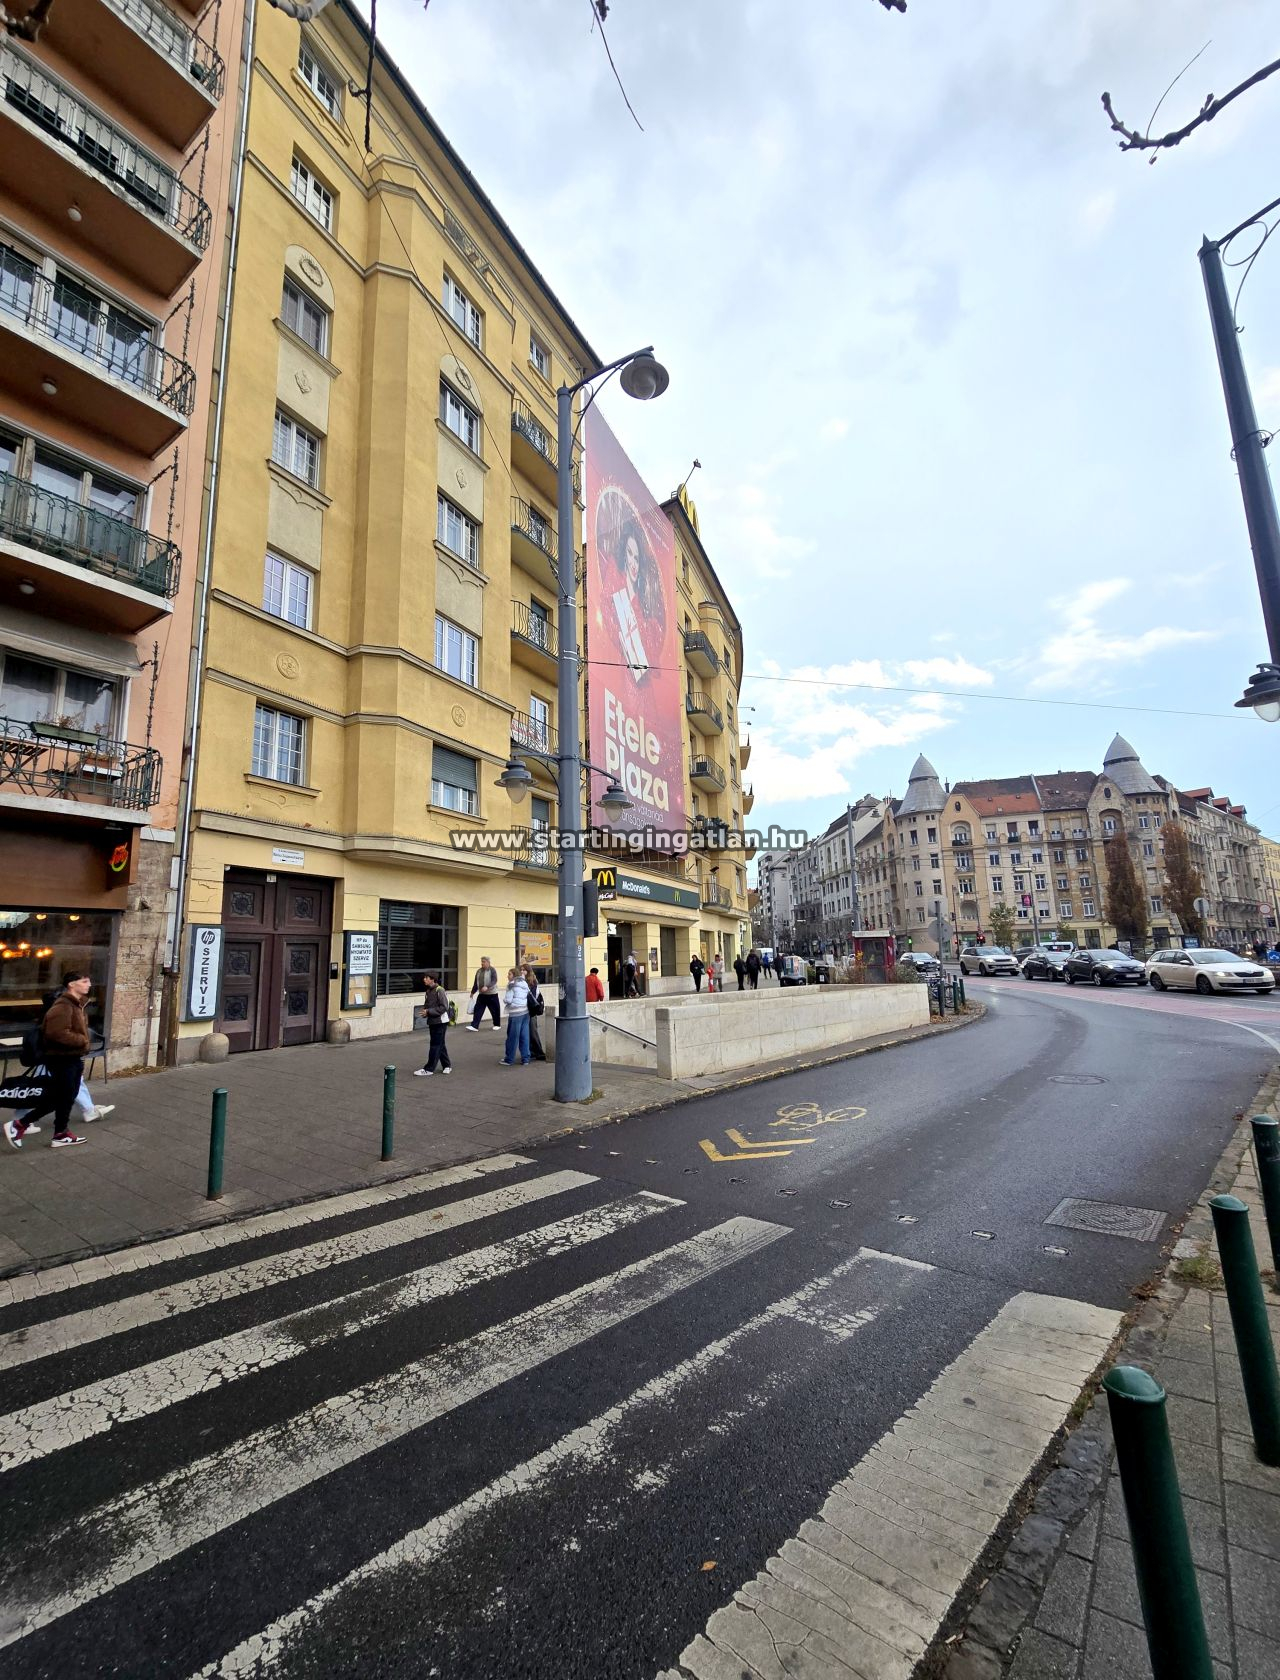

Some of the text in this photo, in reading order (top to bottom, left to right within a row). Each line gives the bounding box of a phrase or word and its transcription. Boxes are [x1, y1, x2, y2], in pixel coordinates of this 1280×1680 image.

[604, 687, 661, 766] Etele
[605, 736, 670, 812] Plaza
[622, 880, 651, 895] McDonald's
[202, 931, 215, 945] hp
[198, 947, 210, 1015] SZERVIZ
[0, 1086, 43, 1099] adidas
